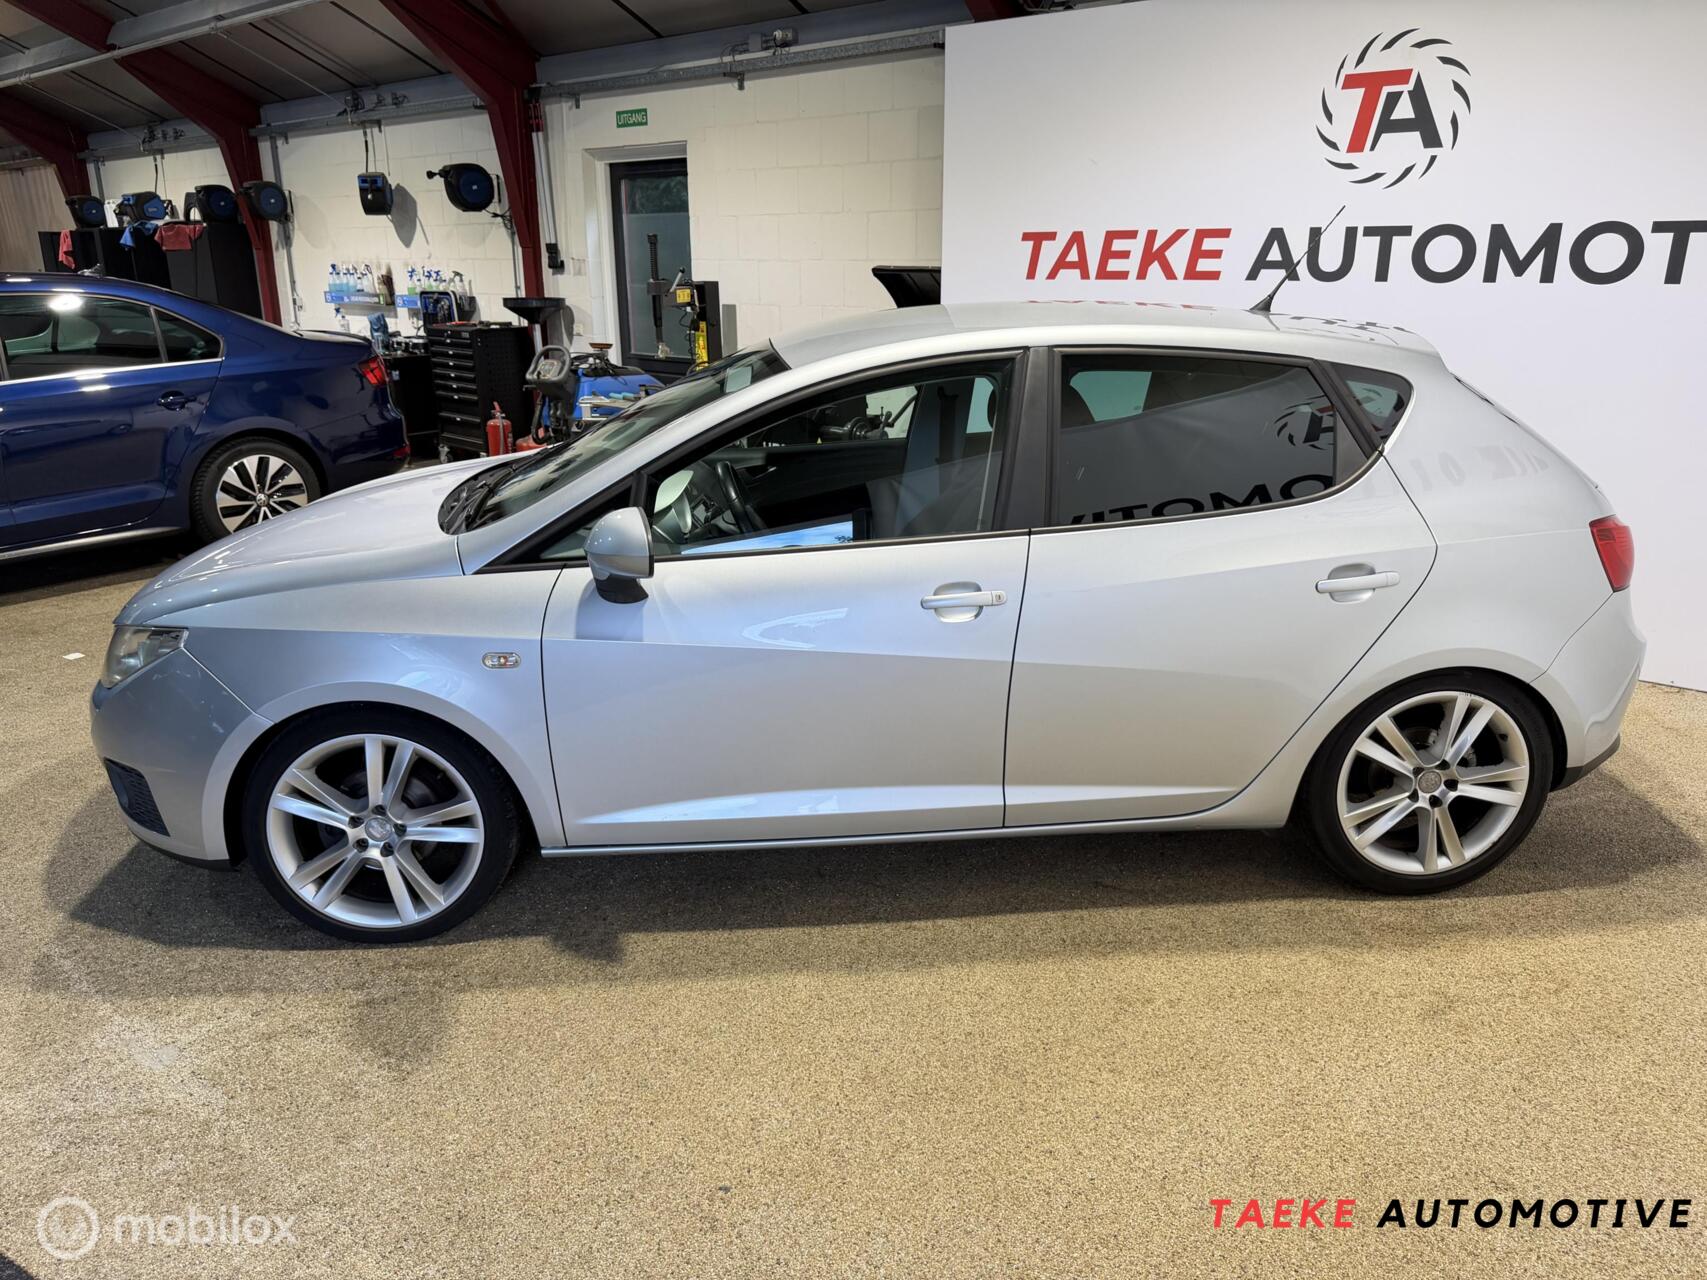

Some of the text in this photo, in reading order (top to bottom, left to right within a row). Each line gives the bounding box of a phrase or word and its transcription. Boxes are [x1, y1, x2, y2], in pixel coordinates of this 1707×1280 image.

[617, 112, 646, 125] UITGANG
[1343, 69, 1442, 153] TA
[1022, 221, 1707, 285] TAEKE AUTOMOT
